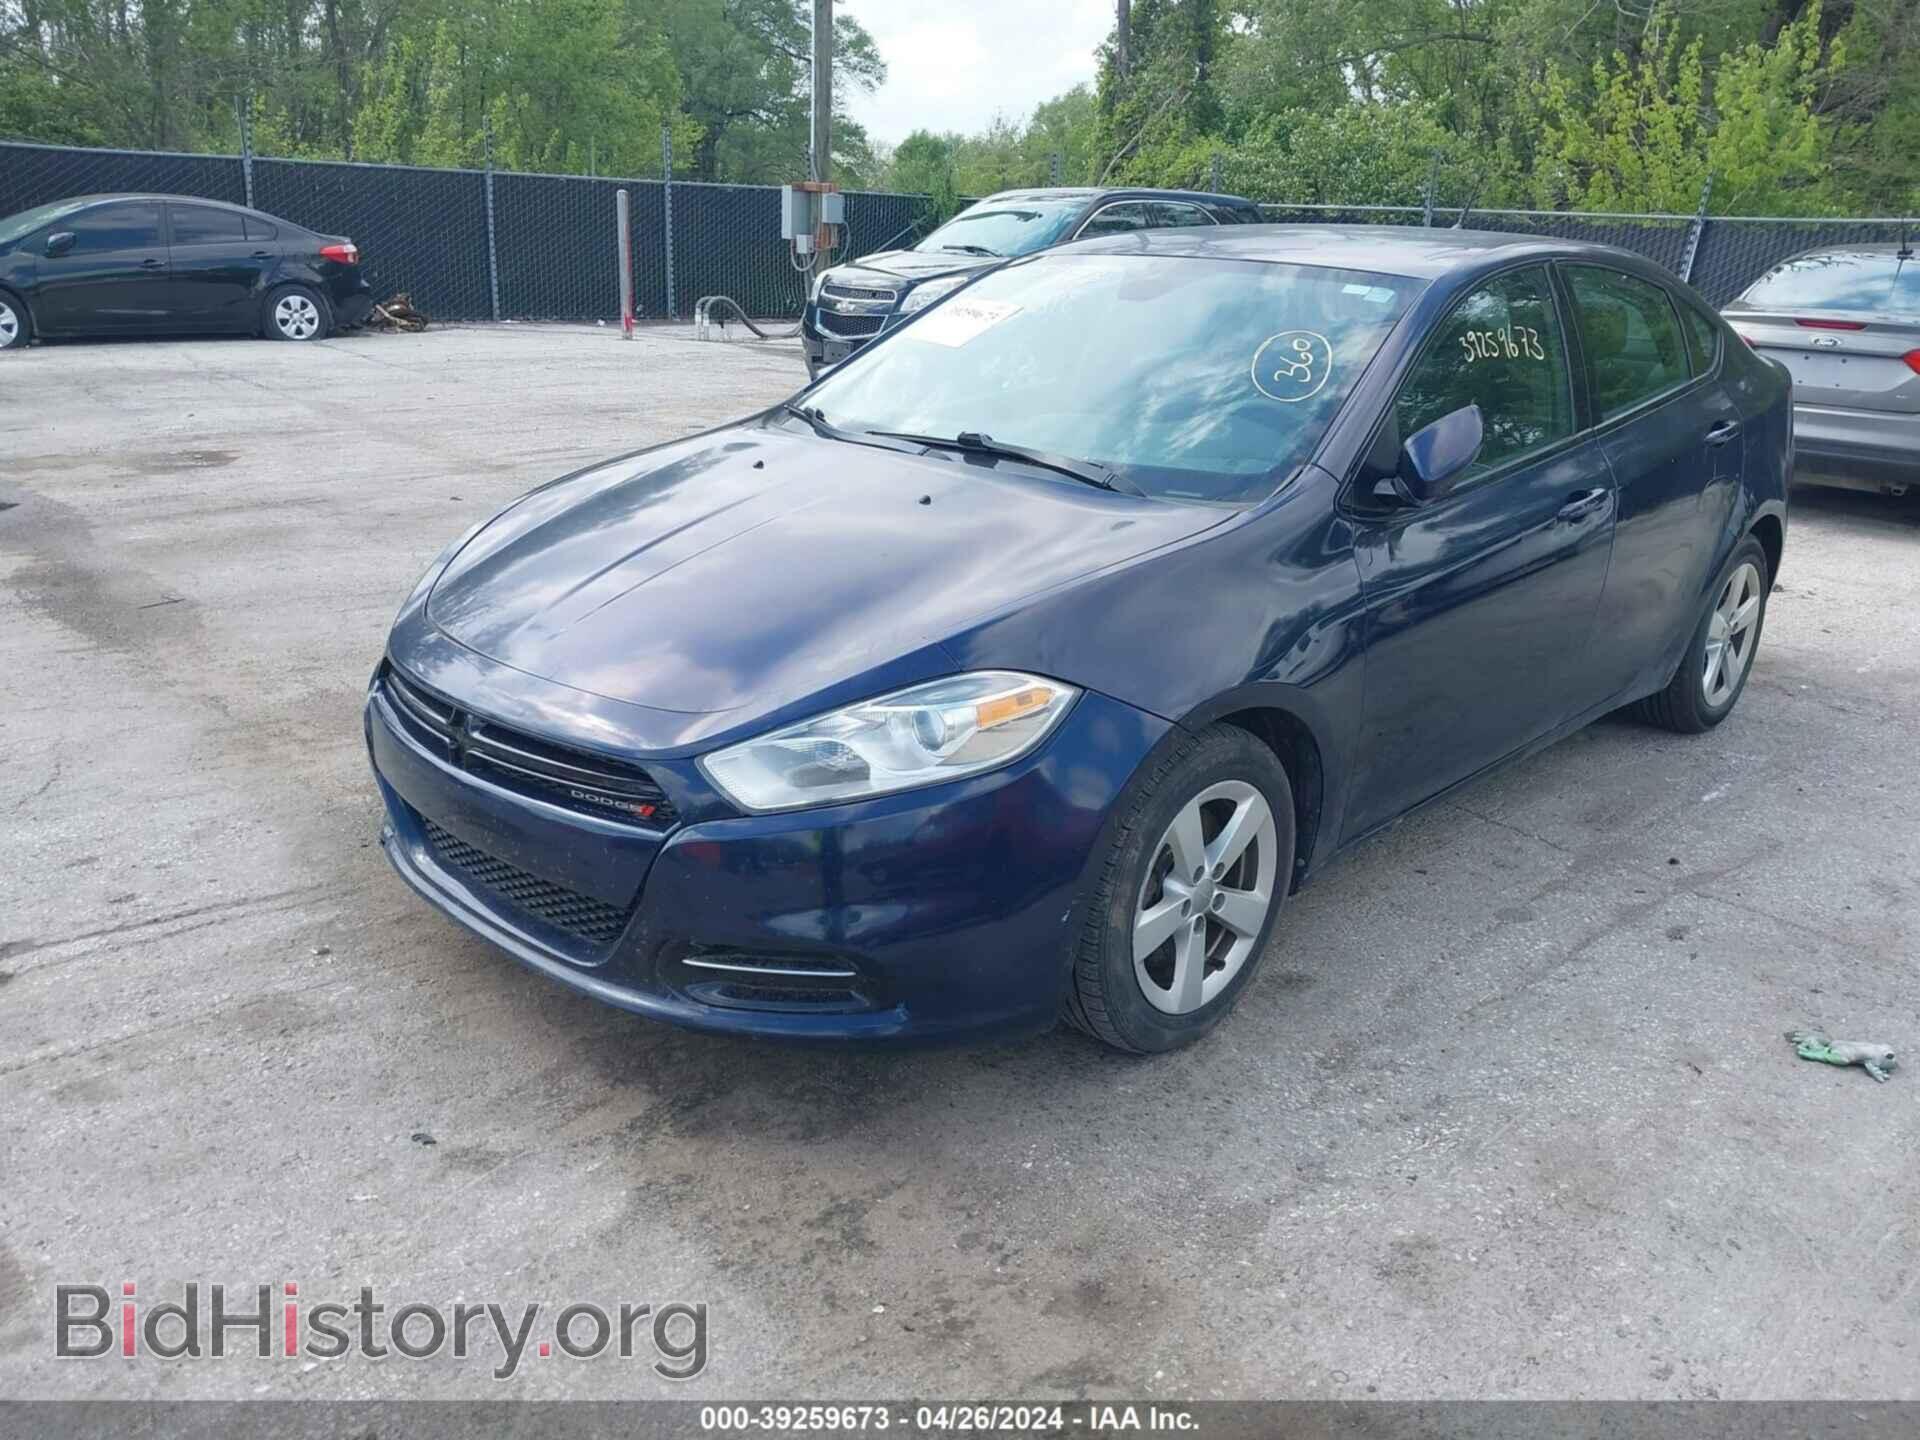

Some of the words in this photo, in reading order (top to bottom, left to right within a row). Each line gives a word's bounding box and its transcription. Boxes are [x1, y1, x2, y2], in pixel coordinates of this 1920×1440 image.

[1274, 338, 1313, 383] 360
[1458, 323, 1545, 362] 39259673
[571, 789, 642, 813] DODGE
